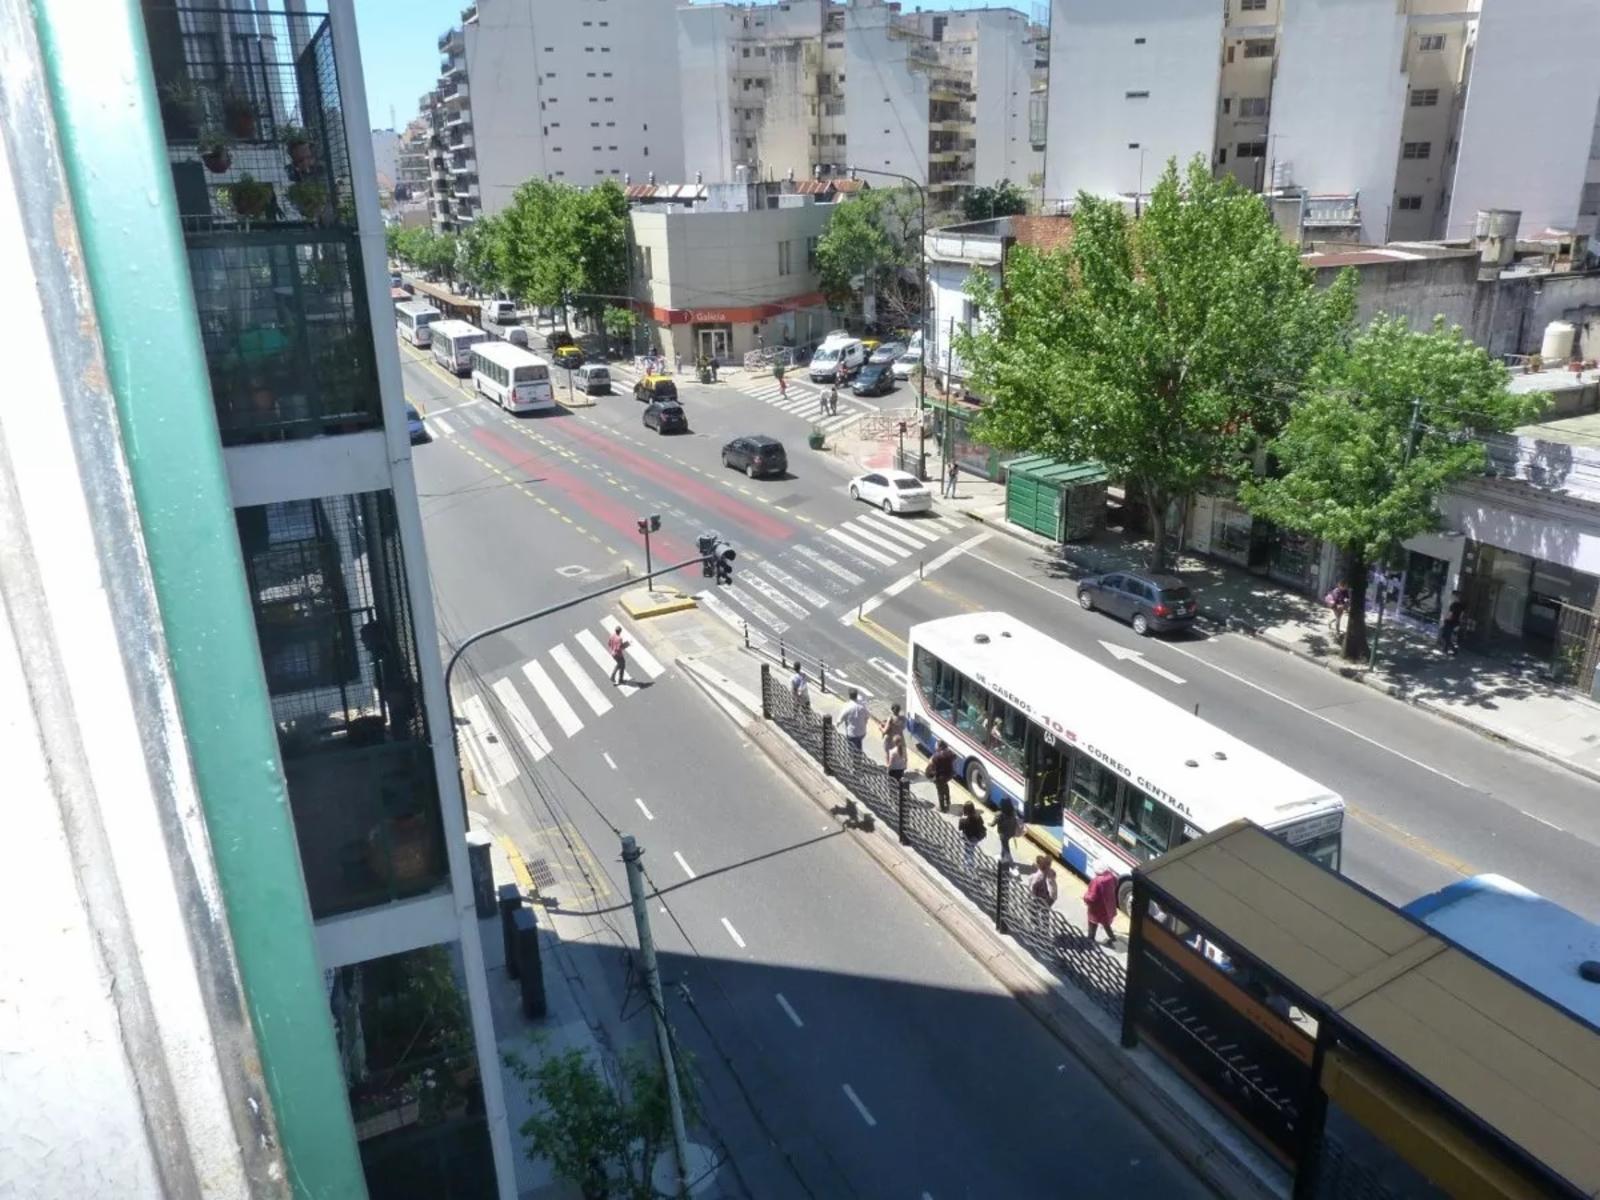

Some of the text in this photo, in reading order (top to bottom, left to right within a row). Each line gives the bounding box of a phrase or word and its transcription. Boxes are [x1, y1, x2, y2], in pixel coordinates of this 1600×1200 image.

[696, 311, 726, 321] Galicia
[992, 683, 1032, 713] CASEROS
[1041, 715, 1077, 742] 105
[1087, 744, 1132, 777] CORREO
[1137, 776, 1193, 818] CENTRAL
